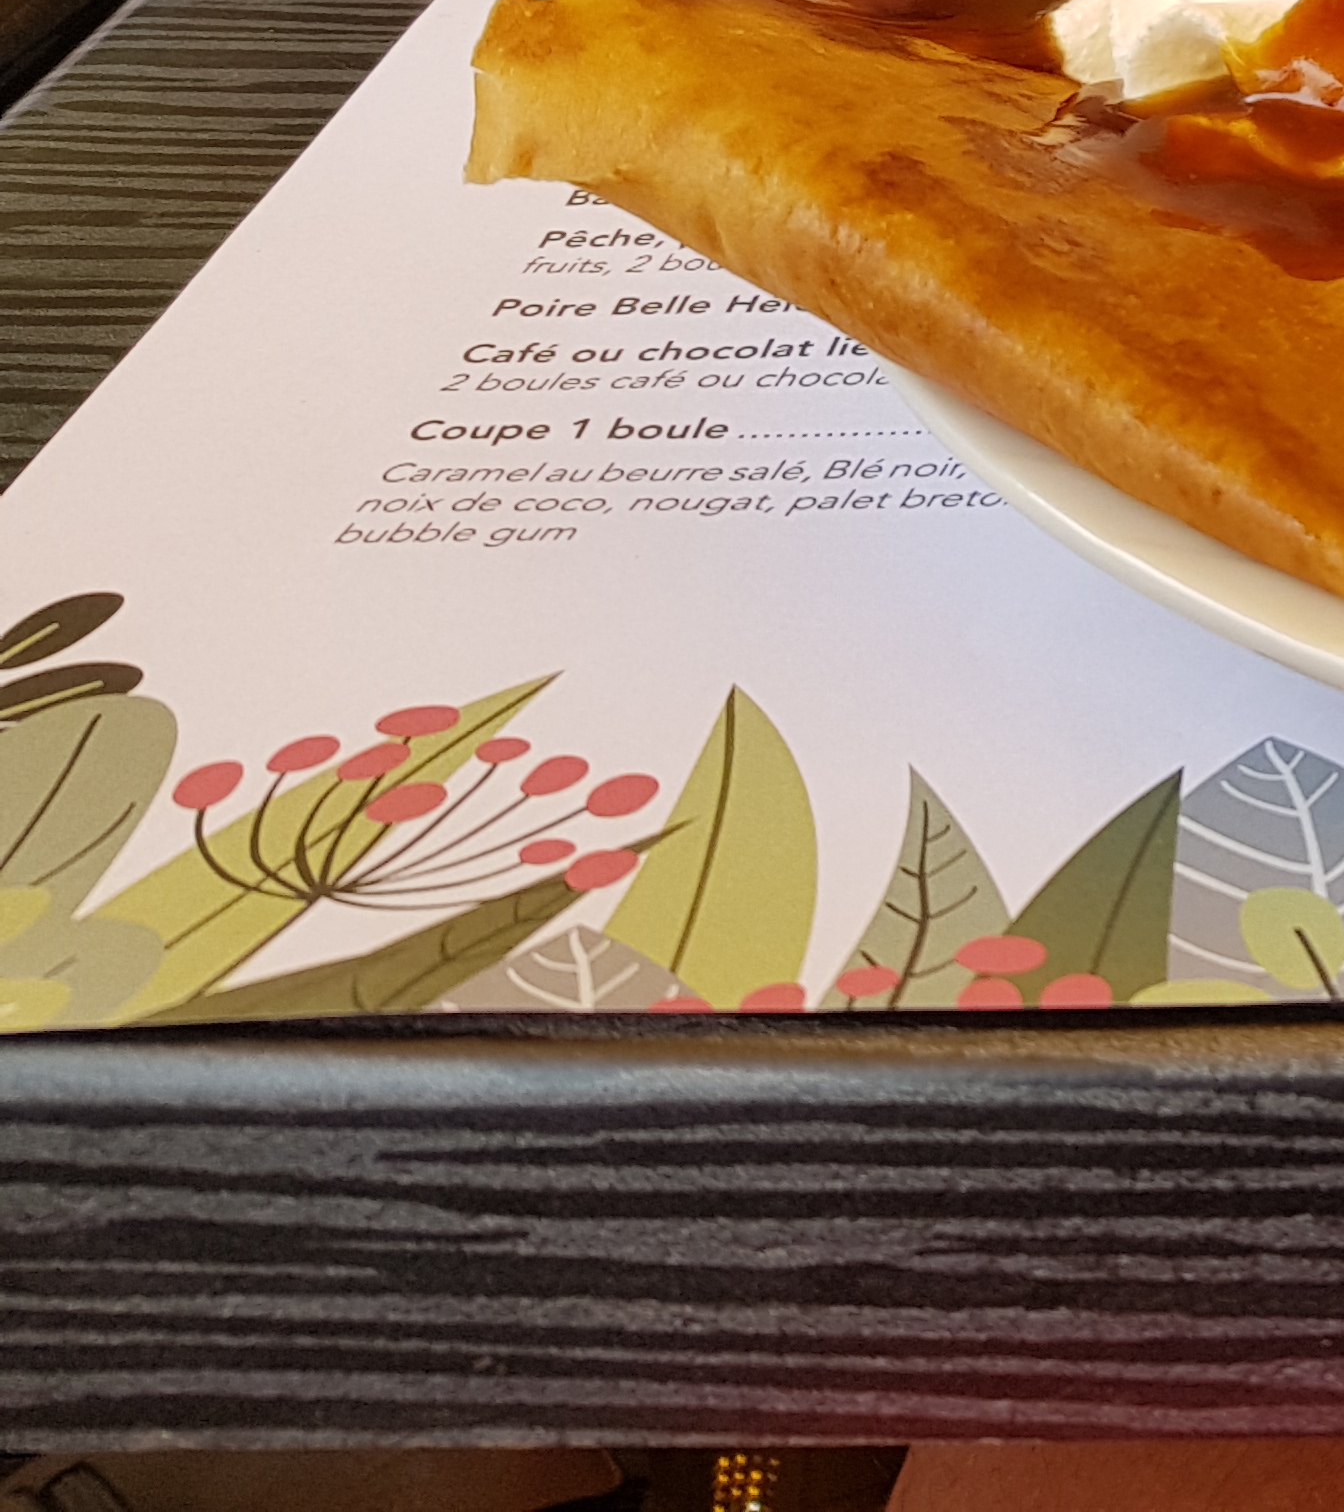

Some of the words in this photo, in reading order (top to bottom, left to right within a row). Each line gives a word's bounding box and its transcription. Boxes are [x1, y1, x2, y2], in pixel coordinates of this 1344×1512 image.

[538, 228, 665, 250] Pêche,
[522, 256, 612, 277] fruits,
[625, 254, 653, 273] 2
[492, 298, 597, 318] Poire
[611, 294, 712, 316] Belle
[463, 342, 559, 364] Café
[571, 348, 625, 364] ou
[638, 339, 815, 362] chocolat
[438, 373, 471, 392] 2
[475, 372, 600, 392] boules
[610, 369, 688, 390] café
[697, 374, 745, 389] ou
[410, 419, 551, 447] Coupe
[572, 417, 592, 439] 1
[607, 416, 730, 439] boule
[382, 462, 546, 484] Caramel
[545, 467, 595, 483] au
[597, 462, 724, 483] beurre
[728, 459, 812, 484] salé,
[823, 457, 887, 480] Blé
[888, 456, 967, 480] noir,
[356, 492, 444, 514] noix
[451, 490, 503, 513] de
[513, 496, 613, 515] coco,
[628, 493, 776, 517] nougat,
[784, 487, 894, 517] palet
[899, 487, 1009, 510] breto
[334, 521, 477, 545] bubble
[483, 525, 578, 548] gum
